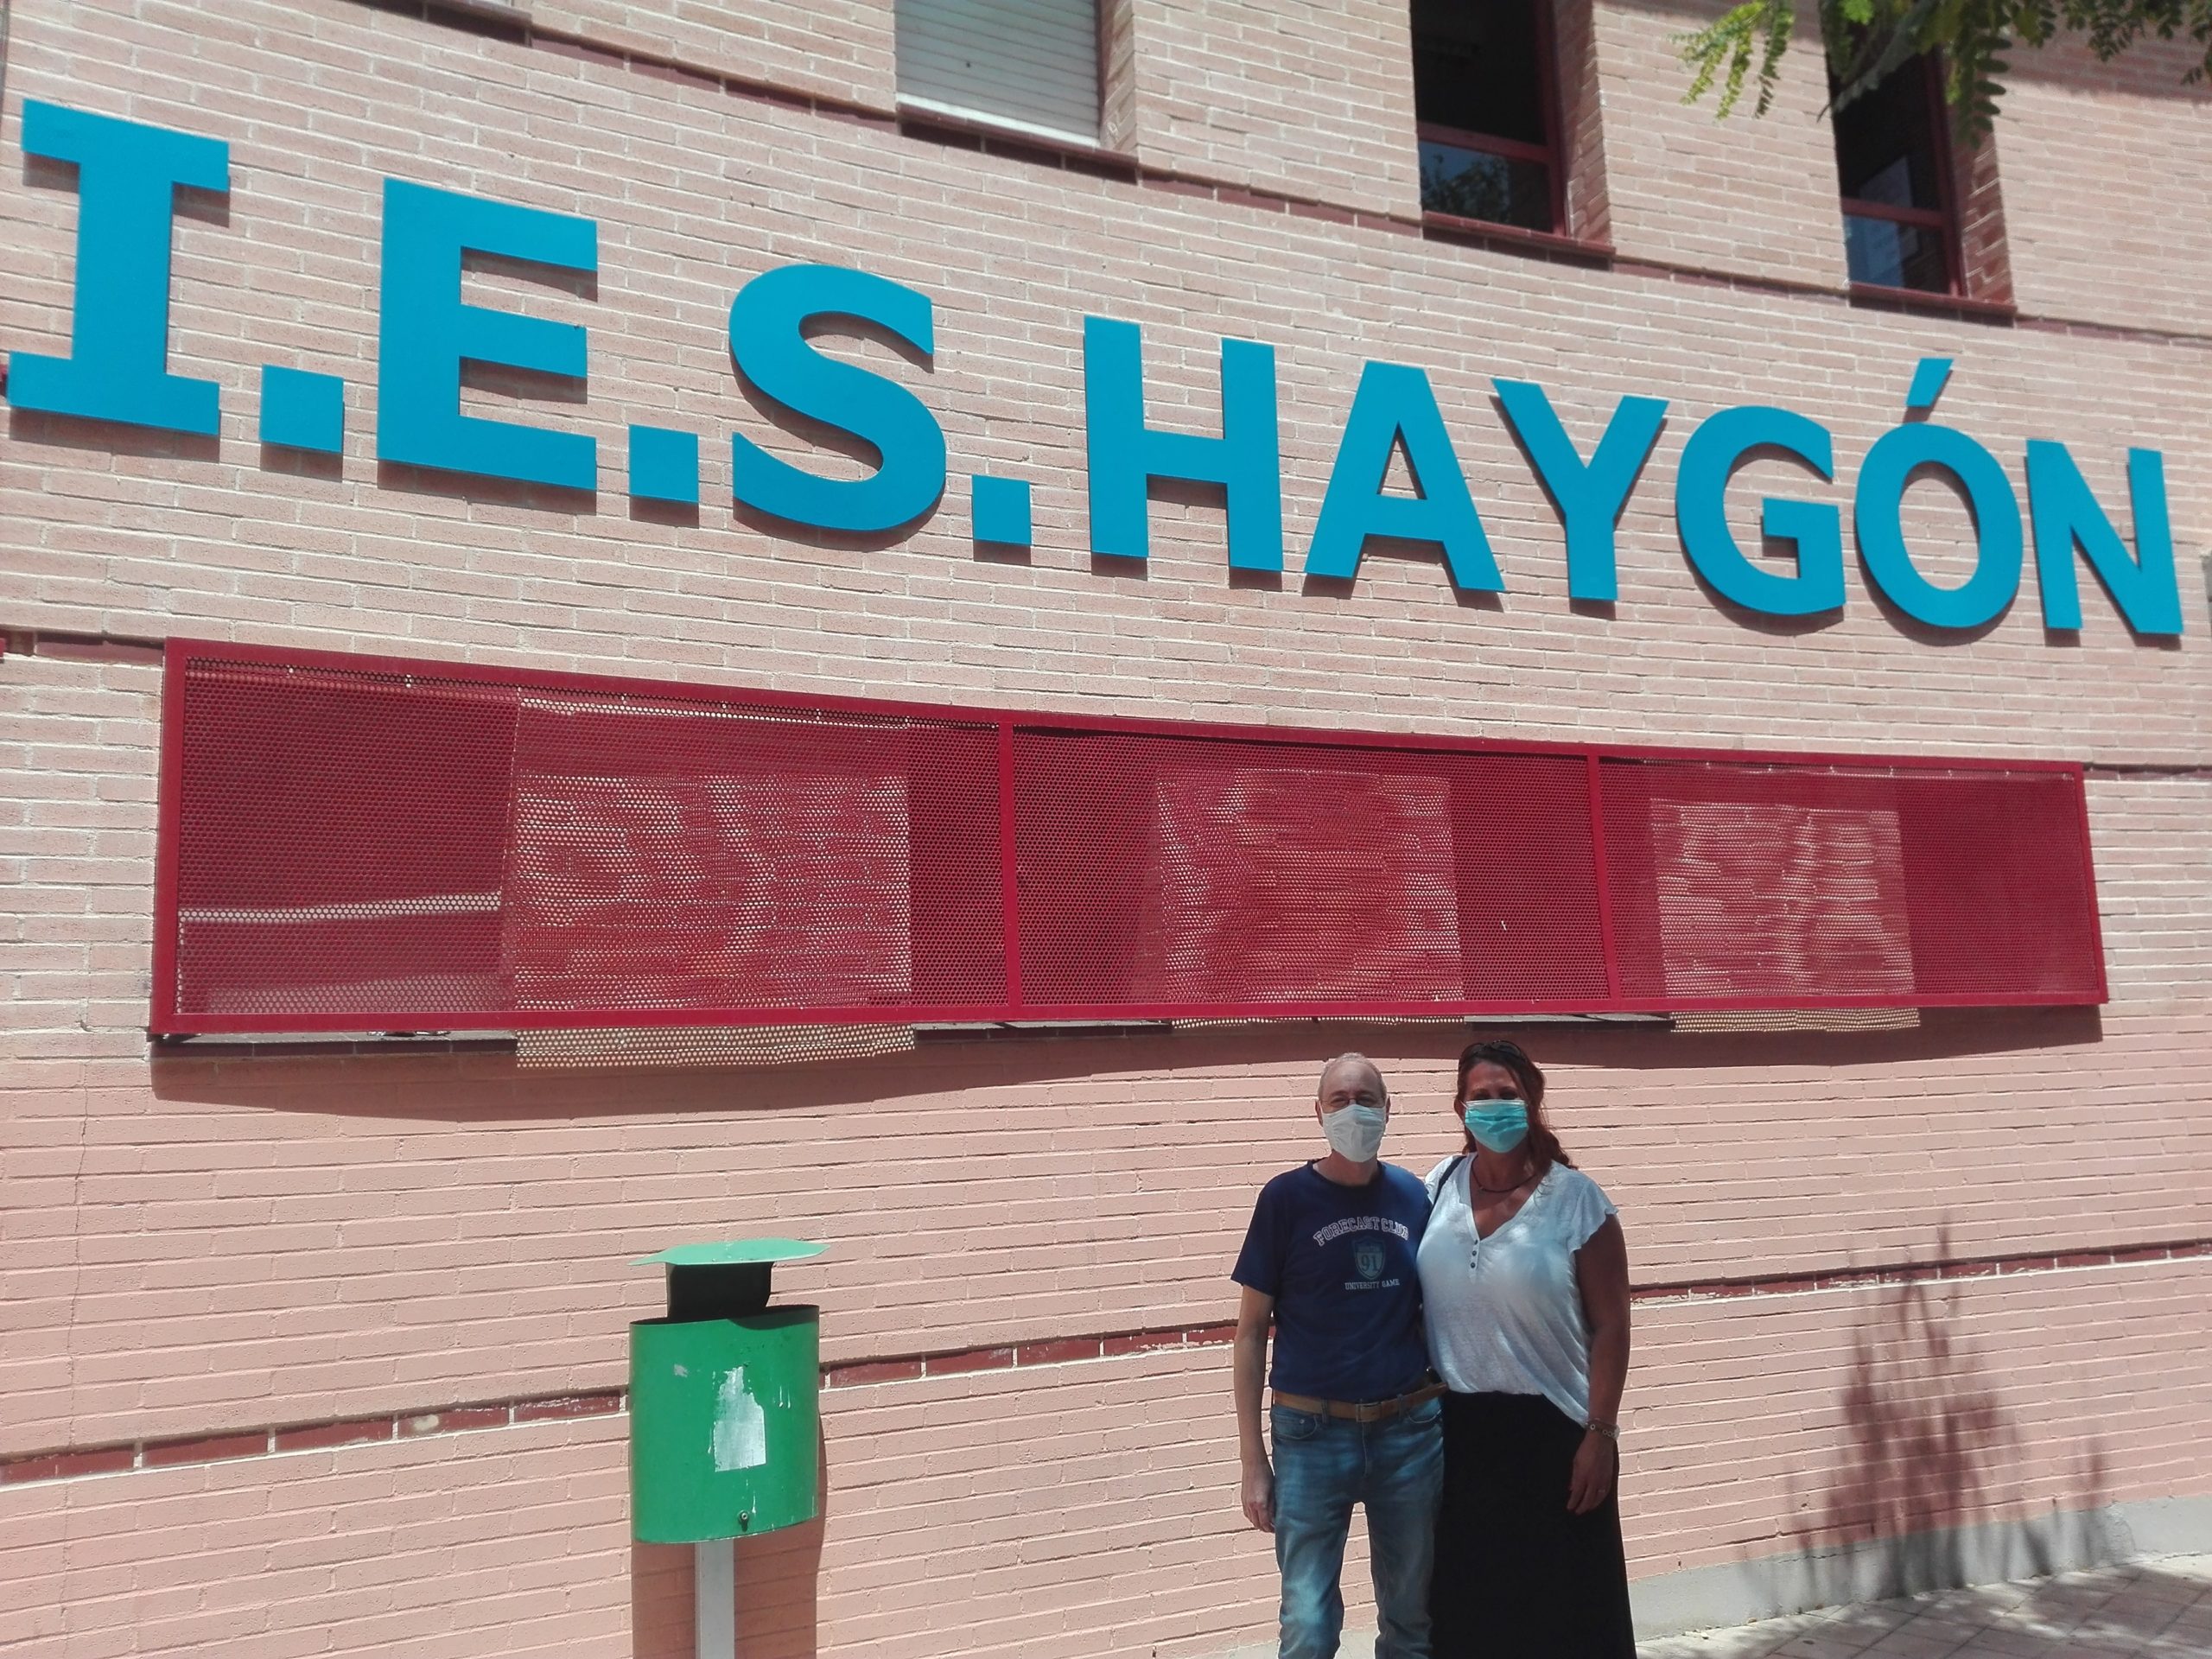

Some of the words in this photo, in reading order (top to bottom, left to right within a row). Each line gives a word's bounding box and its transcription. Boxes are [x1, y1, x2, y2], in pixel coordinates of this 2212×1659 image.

[1084, 316, 2183, 635] HAYGÓN
[1313, 1216, 1380, 1247] FORECAST
[1381, 1217, 1409, 1241] CLUB
[1361, 1254, 1378, 1271] 91
[1344, 1281, 1380, 1290] UNIVERSITY
[1382, 1279, 1400, 1287] GAME
